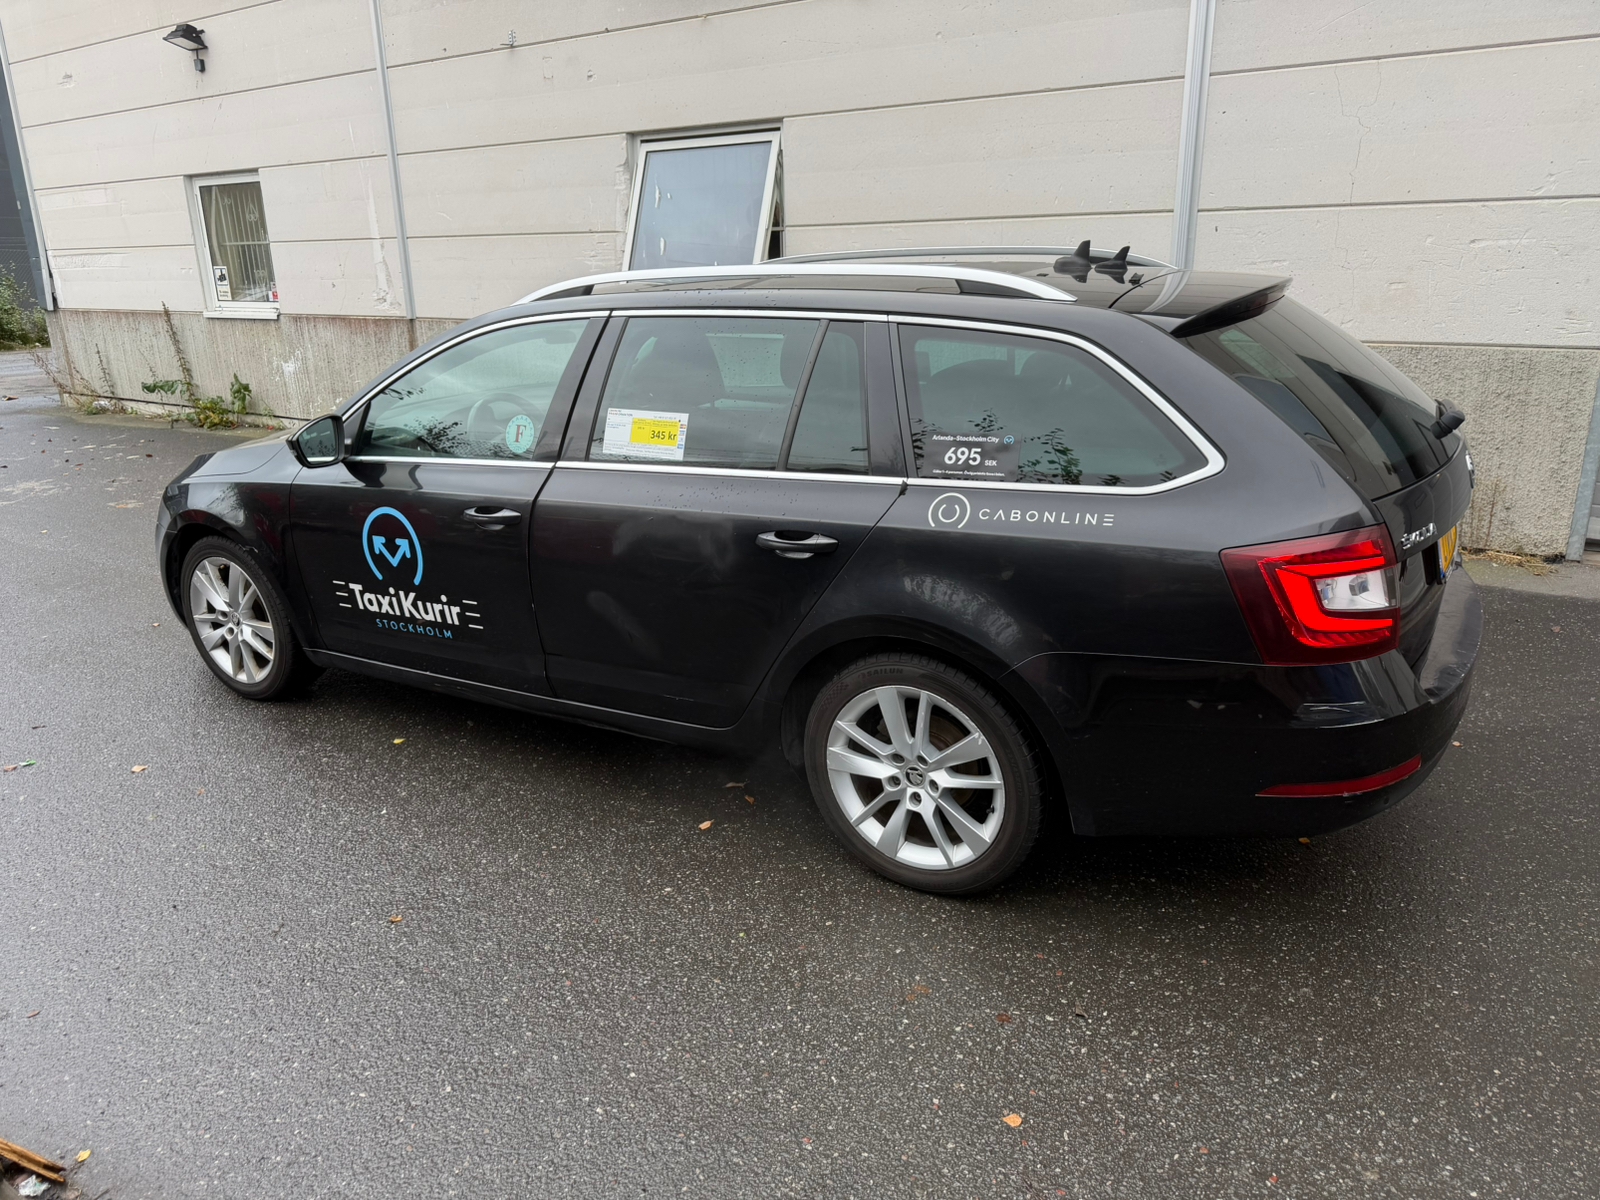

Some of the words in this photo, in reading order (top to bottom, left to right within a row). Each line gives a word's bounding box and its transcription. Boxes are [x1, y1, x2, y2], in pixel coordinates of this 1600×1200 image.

[514, 424, 527, 443] F
[650, 430, 666, 440] 345
[667, 431, 677, 441] kr
[986, 436, 1000, 444] City
[944, 447, 982, 466] 695
[978, 508, 1115, 527] CABONLINE
[376, 618, 453, 639] STOCKHOLM
[867, 667, 904, 677] SAILUN
